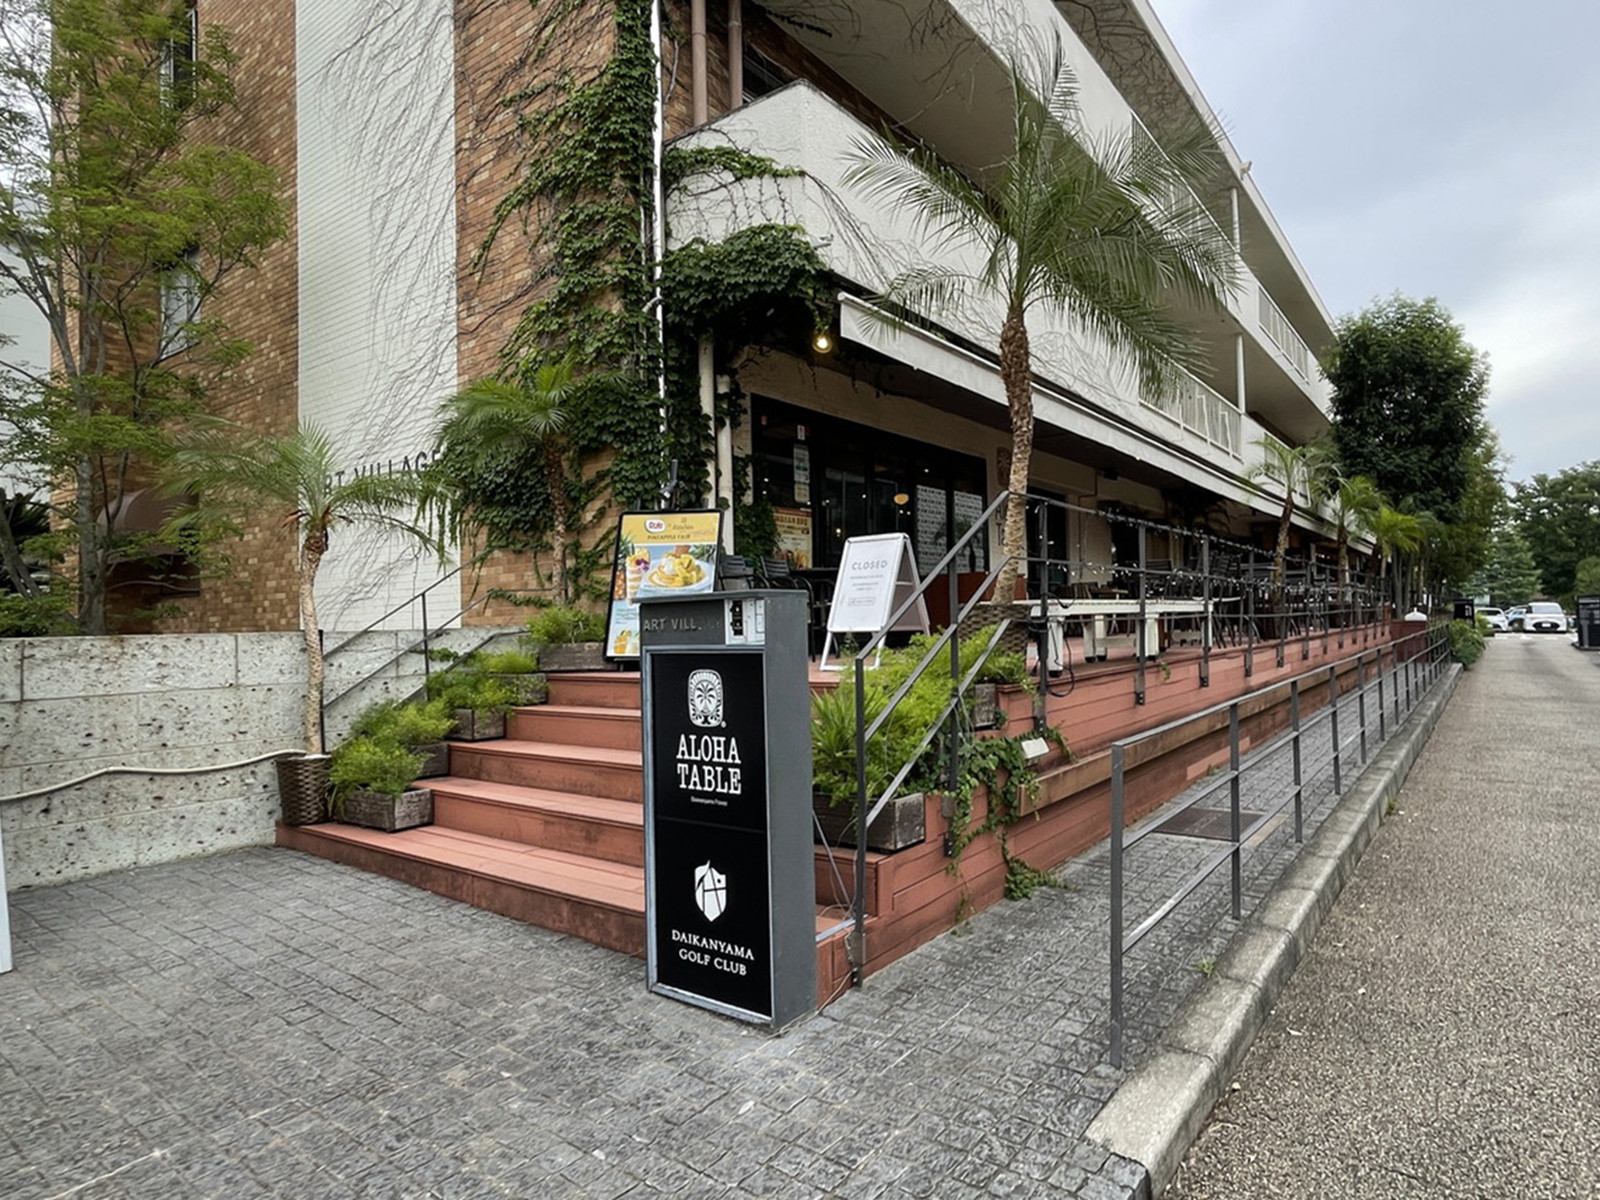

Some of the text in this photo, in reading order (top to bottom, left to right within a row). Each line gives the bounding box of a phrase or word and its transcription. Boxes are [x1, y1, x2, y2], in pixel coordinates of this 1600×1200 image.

[851, 559, 888, 571] CLOSED
[643, 618, 666, 631] ART
[676, 734, 741, 764] ALOHA
[677, 763, 741, 794] TABLE
[671, 929, 755, 961] DAIKANYAMA
[678, 948, 747, 976] GOLF CLUB
